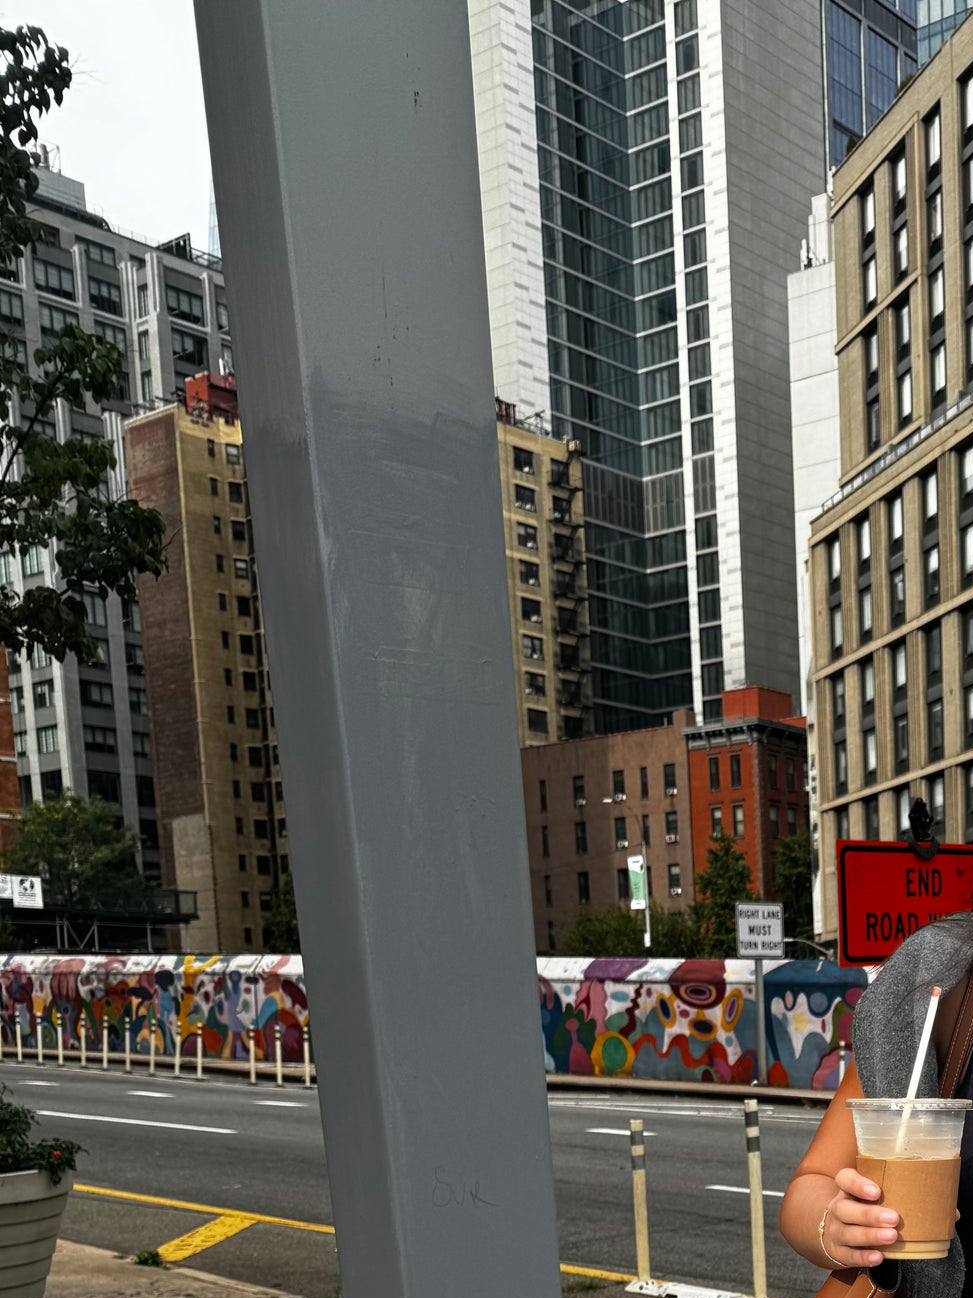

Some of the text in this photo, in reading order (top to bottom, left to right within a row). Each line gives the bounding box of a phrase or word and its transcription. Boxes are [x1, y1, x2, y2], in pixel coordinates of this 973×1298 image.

[905, 867, 942, 897] END
[739, 910, 781, 920] RIGHT LANE
[748, 925, 771, 936] MUST
[865, 912, 919, 942] ROAD
[740, 941, 782, 951] TURN RIGHT
